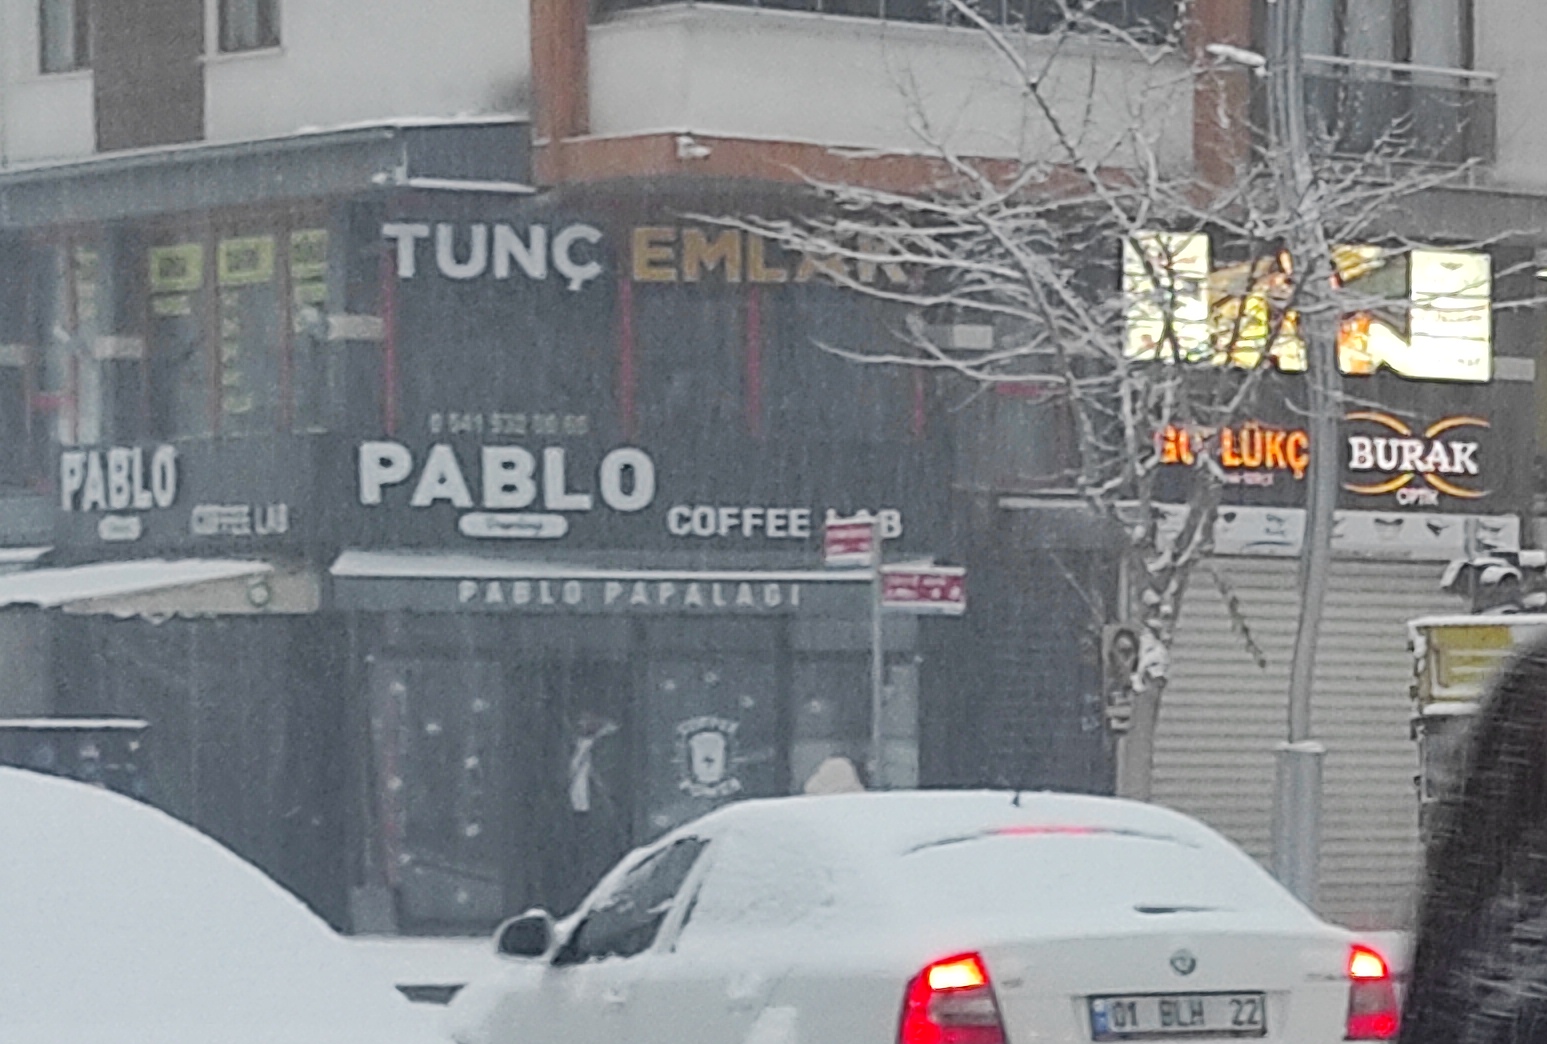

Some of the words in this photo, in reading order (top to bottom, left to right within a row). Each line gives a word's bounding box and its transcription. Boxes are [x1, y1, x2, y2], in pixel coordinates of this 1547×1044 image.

[383, 224, 602, 290] TUNÇ
[1348, 436, 1479, 474] BURAK
[61, 445, 176, 511] PABLO
[359, 441, 655, 511] PABLO
[667, 505, 811, 537] COFFEE
[458, 580, 581, 604] PABLO
[1229, 997, 1259, 1026] 22
